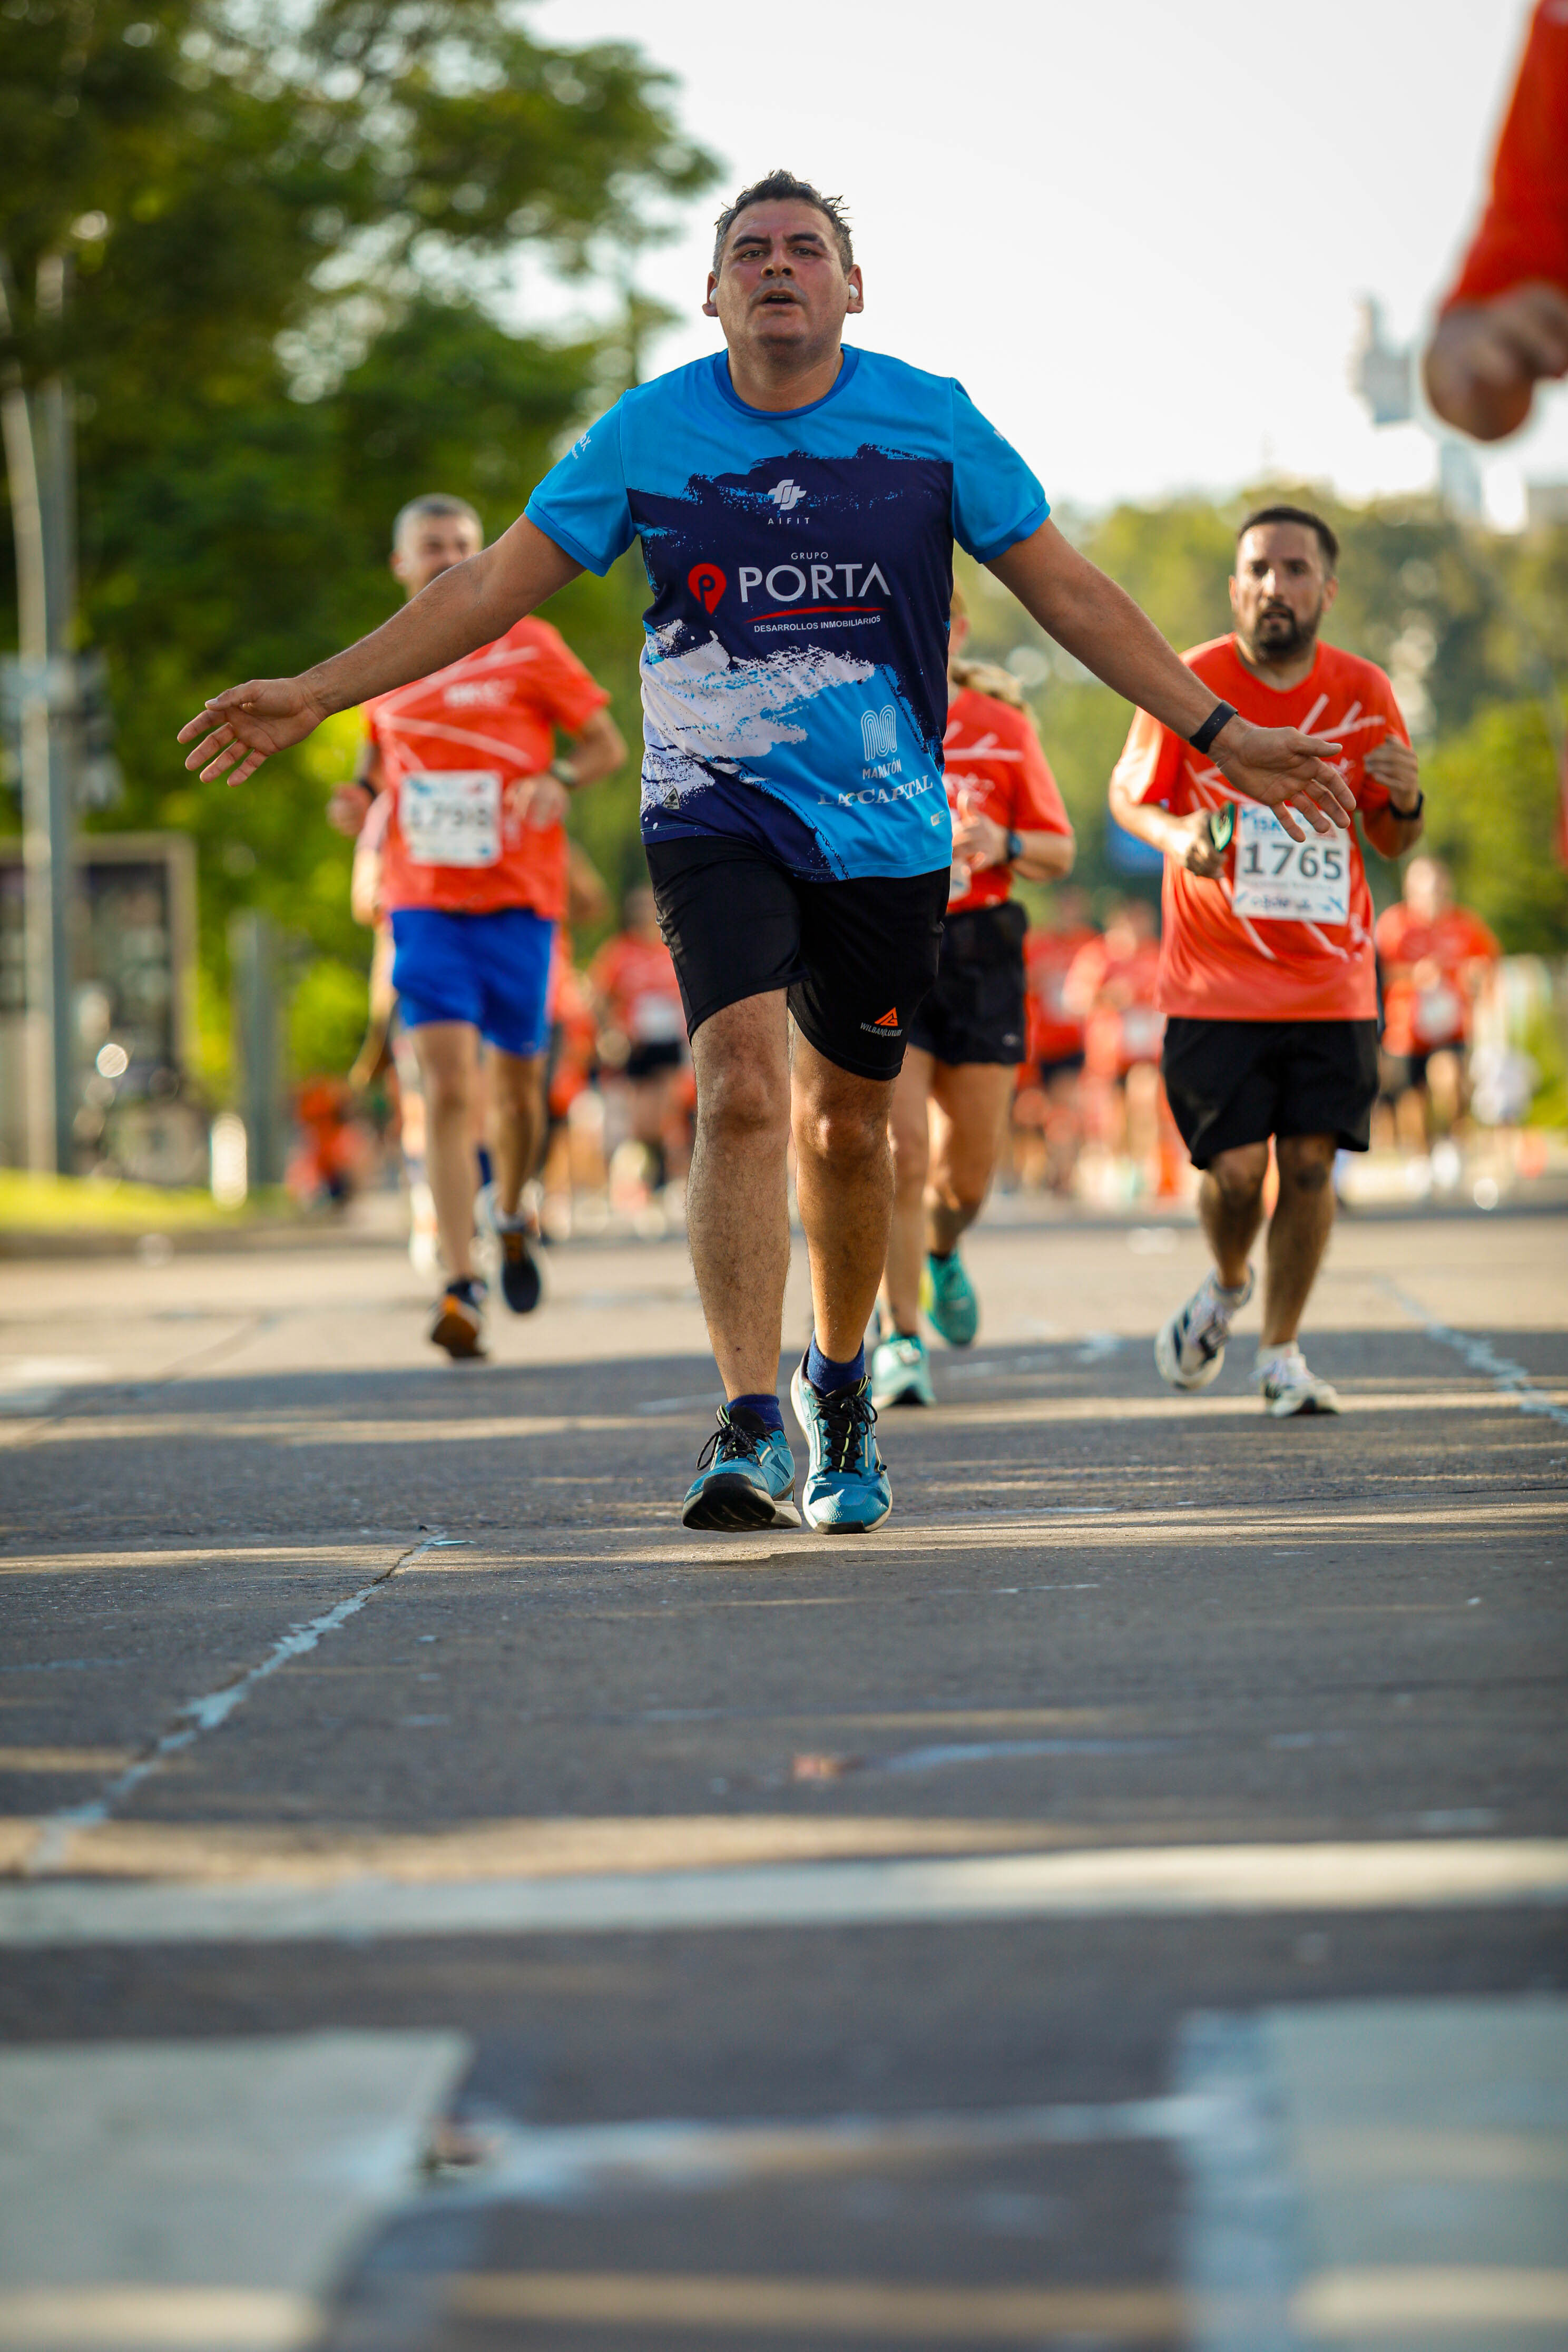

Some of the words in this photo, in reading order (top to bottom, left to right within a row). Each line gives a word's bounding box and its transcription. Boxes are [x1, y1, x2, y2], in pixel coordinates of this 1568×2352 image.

[791, 552, 829, 560] GRUPO
[739, 562, 891, 603] PORTA
[754, 622, 819, 633] DESARROLLOS
[820, 615, 881, 629] INMOBILIARIOS
[863, 758, 902, 780] MARATÓN
[1243, 842, 1342, 880] 1765
